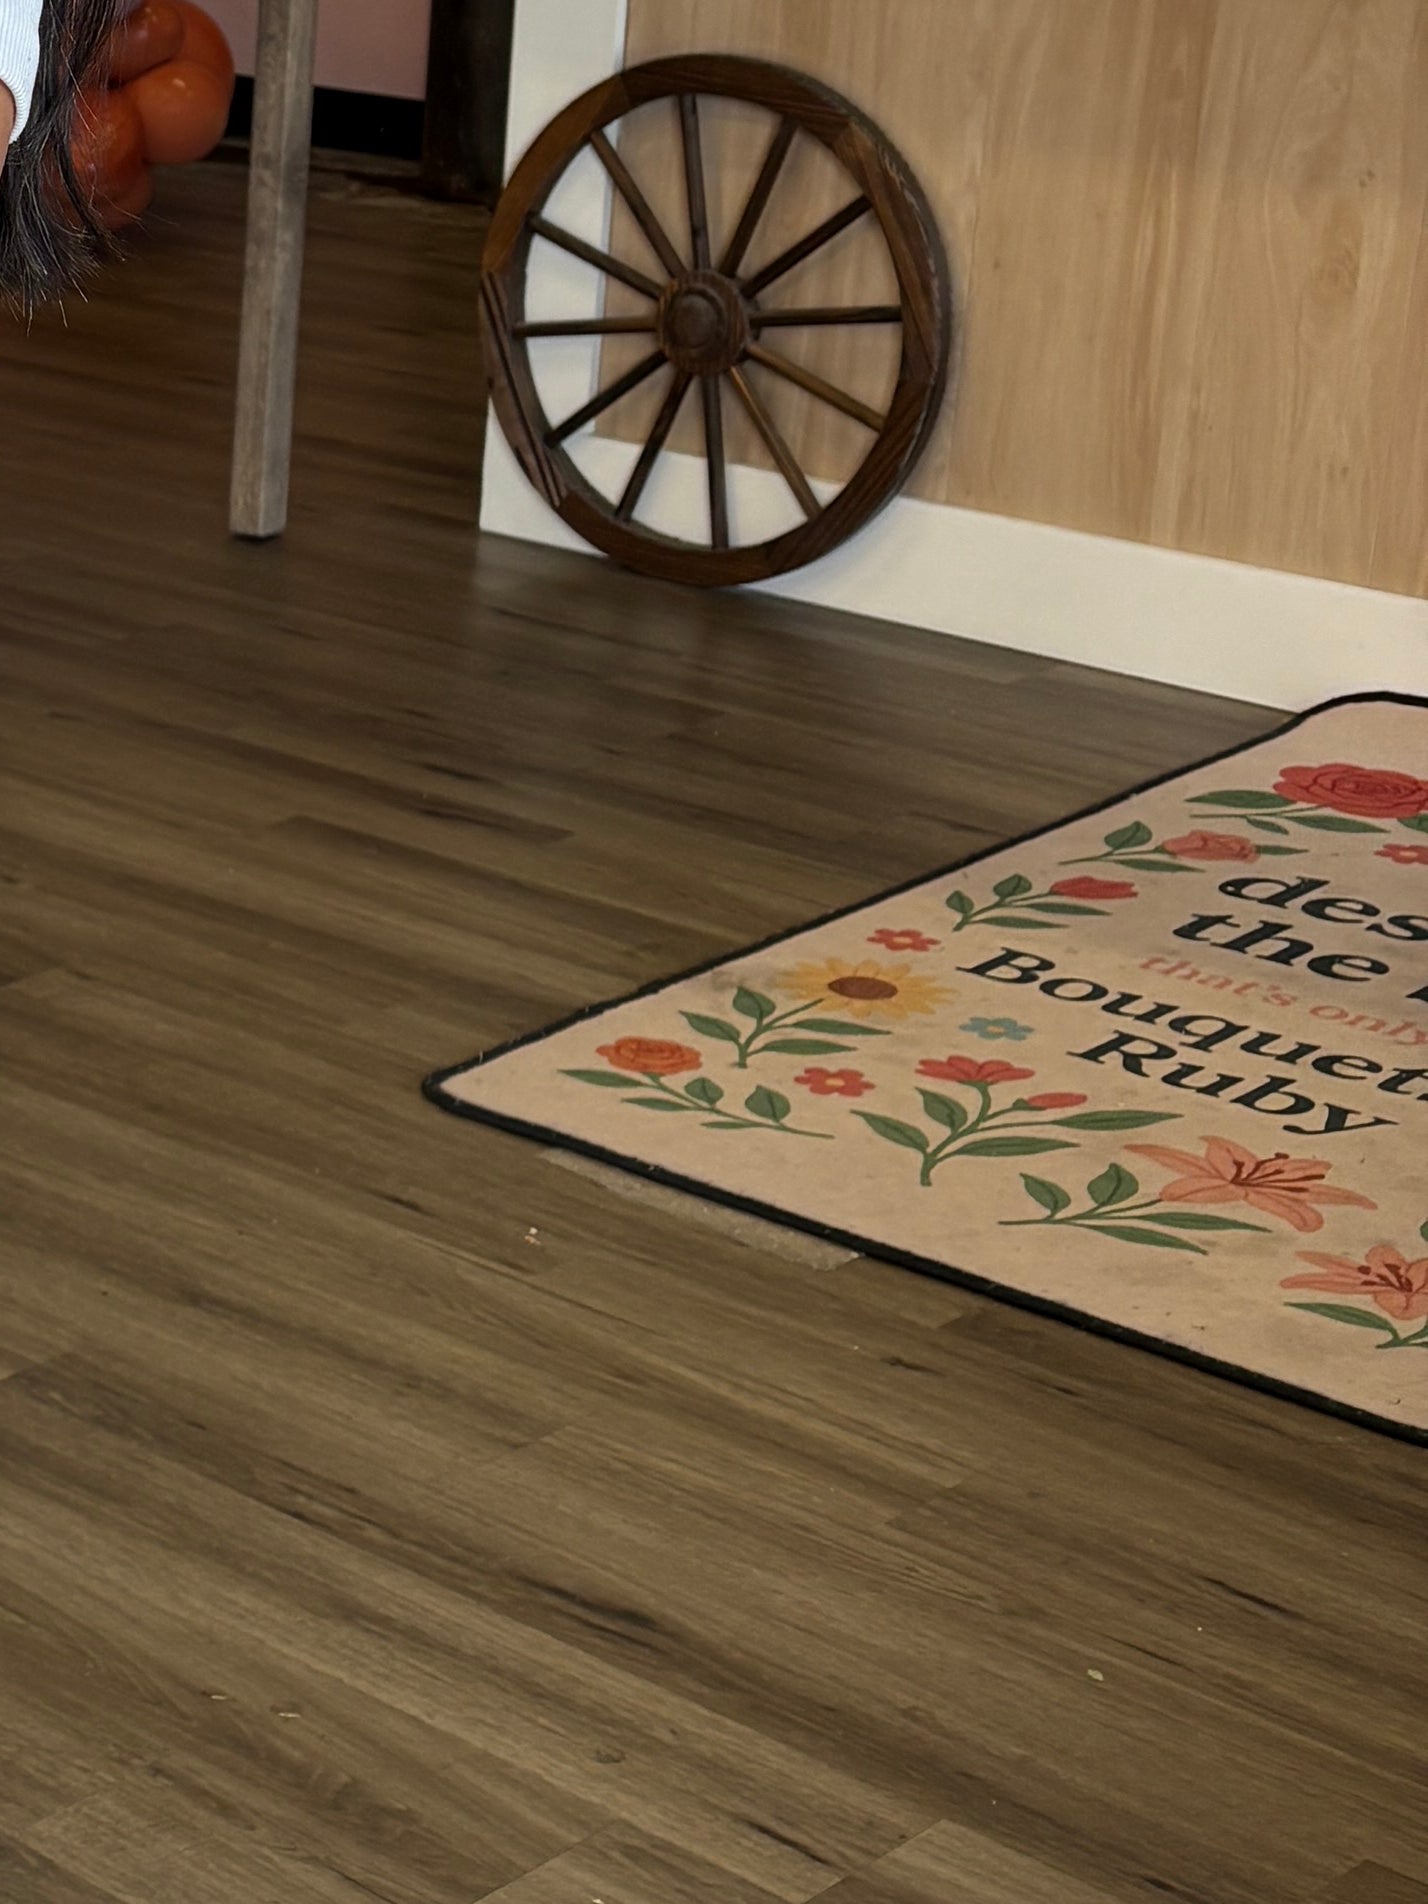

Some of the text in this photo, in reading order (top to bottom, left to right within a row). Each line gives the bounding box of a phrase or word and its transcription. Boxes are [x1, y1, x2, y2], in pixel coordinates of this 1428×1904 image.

[1138, 953, 1298, 1008] that's
[1172, 912, 1391, 982] the
[954, 946, 1428, 1102] Bouquet
[1065, 1029, 1400, 1136] Ruby
